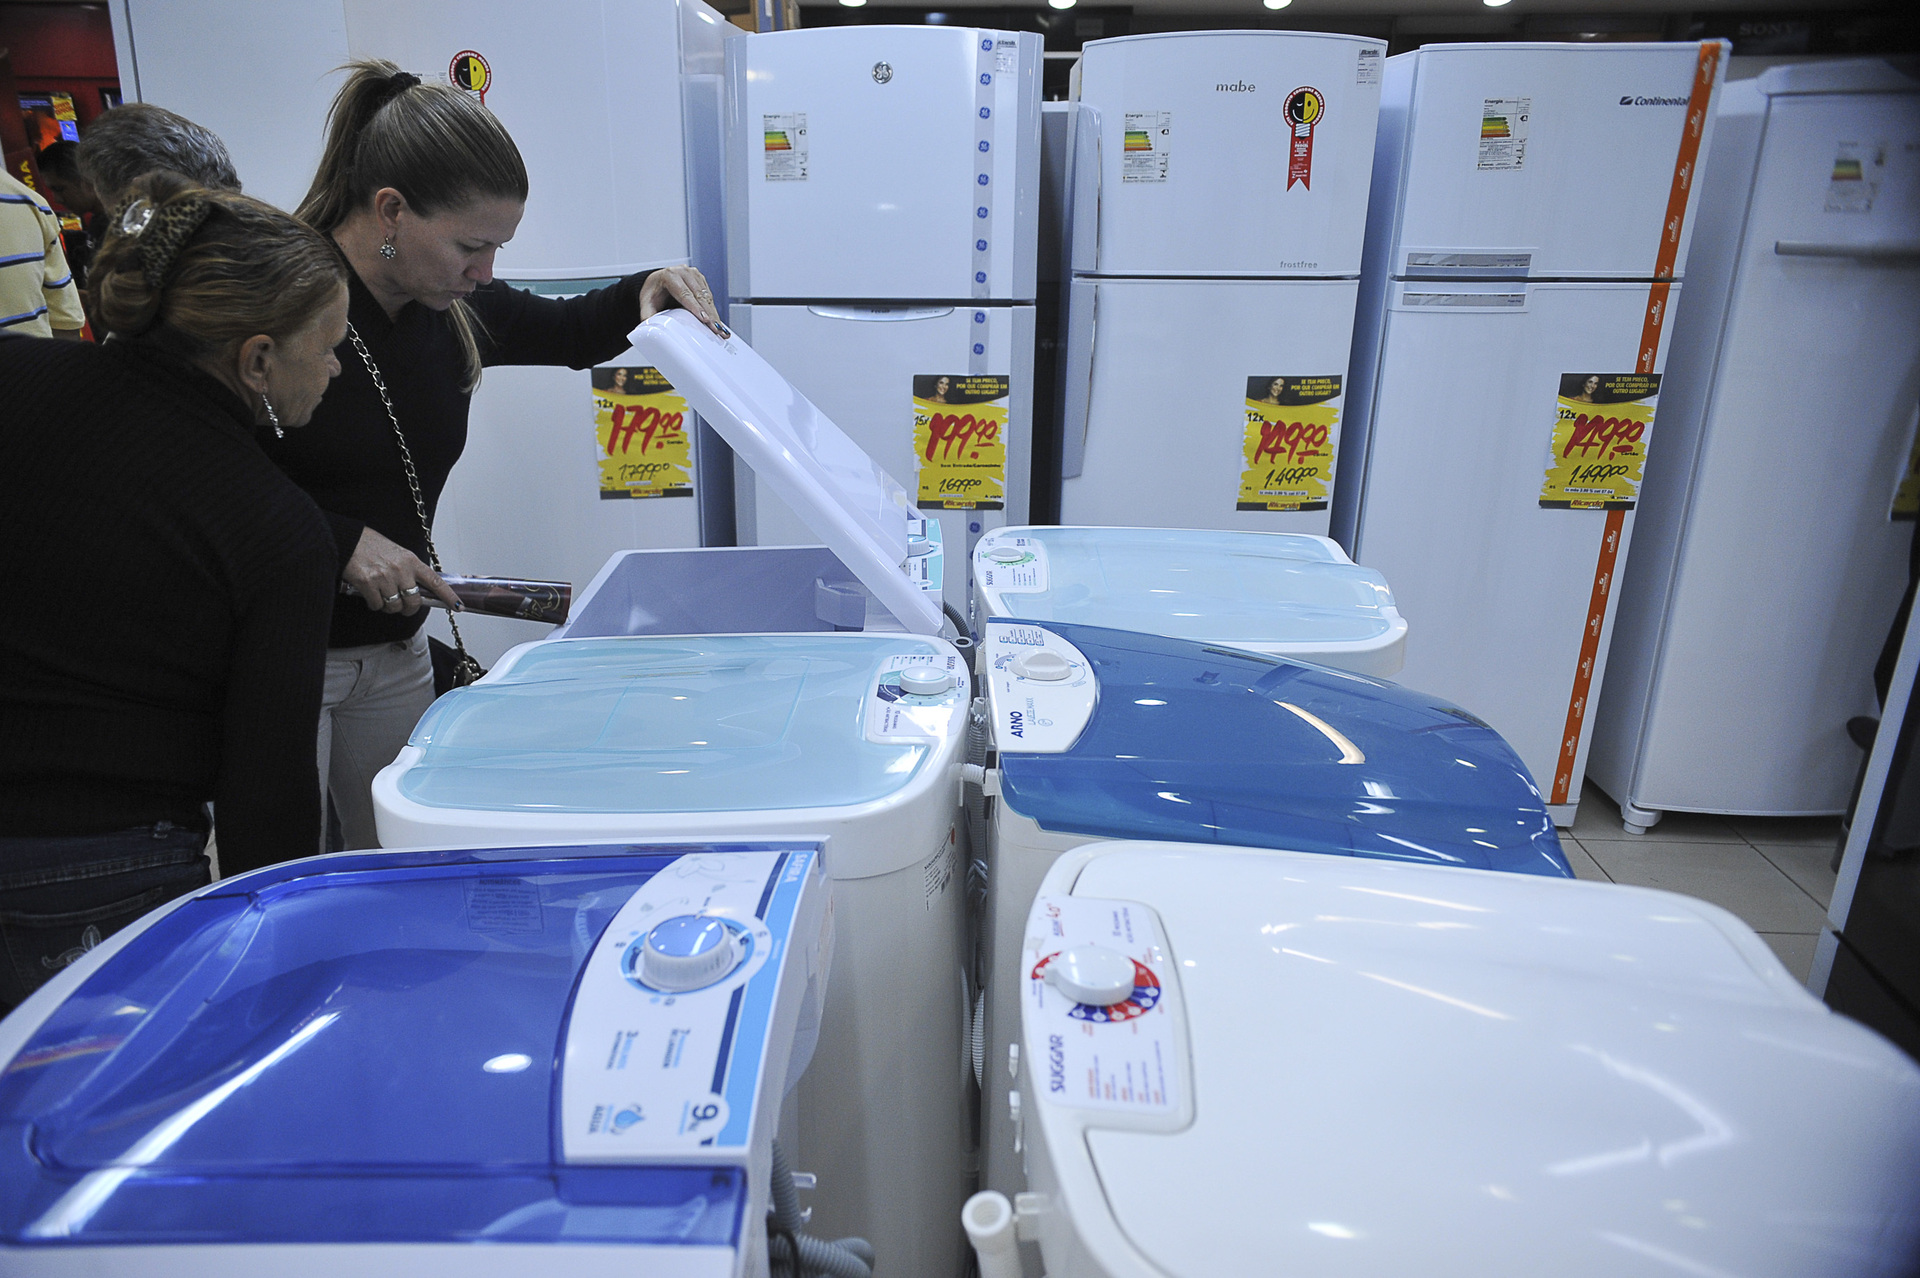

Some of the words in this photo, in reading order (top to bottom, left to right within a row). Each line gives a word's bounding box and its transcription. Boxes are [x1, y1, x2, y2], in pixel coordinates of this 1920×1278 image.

[1739, 22, 1793, 35] SONY
[1216, 80, 1256, 92] mabe
[1635, 96, 1691, 106] Continental
[1247, 412, 1264, 422] 12x
[1560, 410, 1577, 420] 12x
[1010, 711, 1023, 738] ARNO
[783, 854, 808, 883] SAFIRA
[1050, 1034, 1066, 1094] SUGGAR
[693, 1104, 718, 1122] 9
